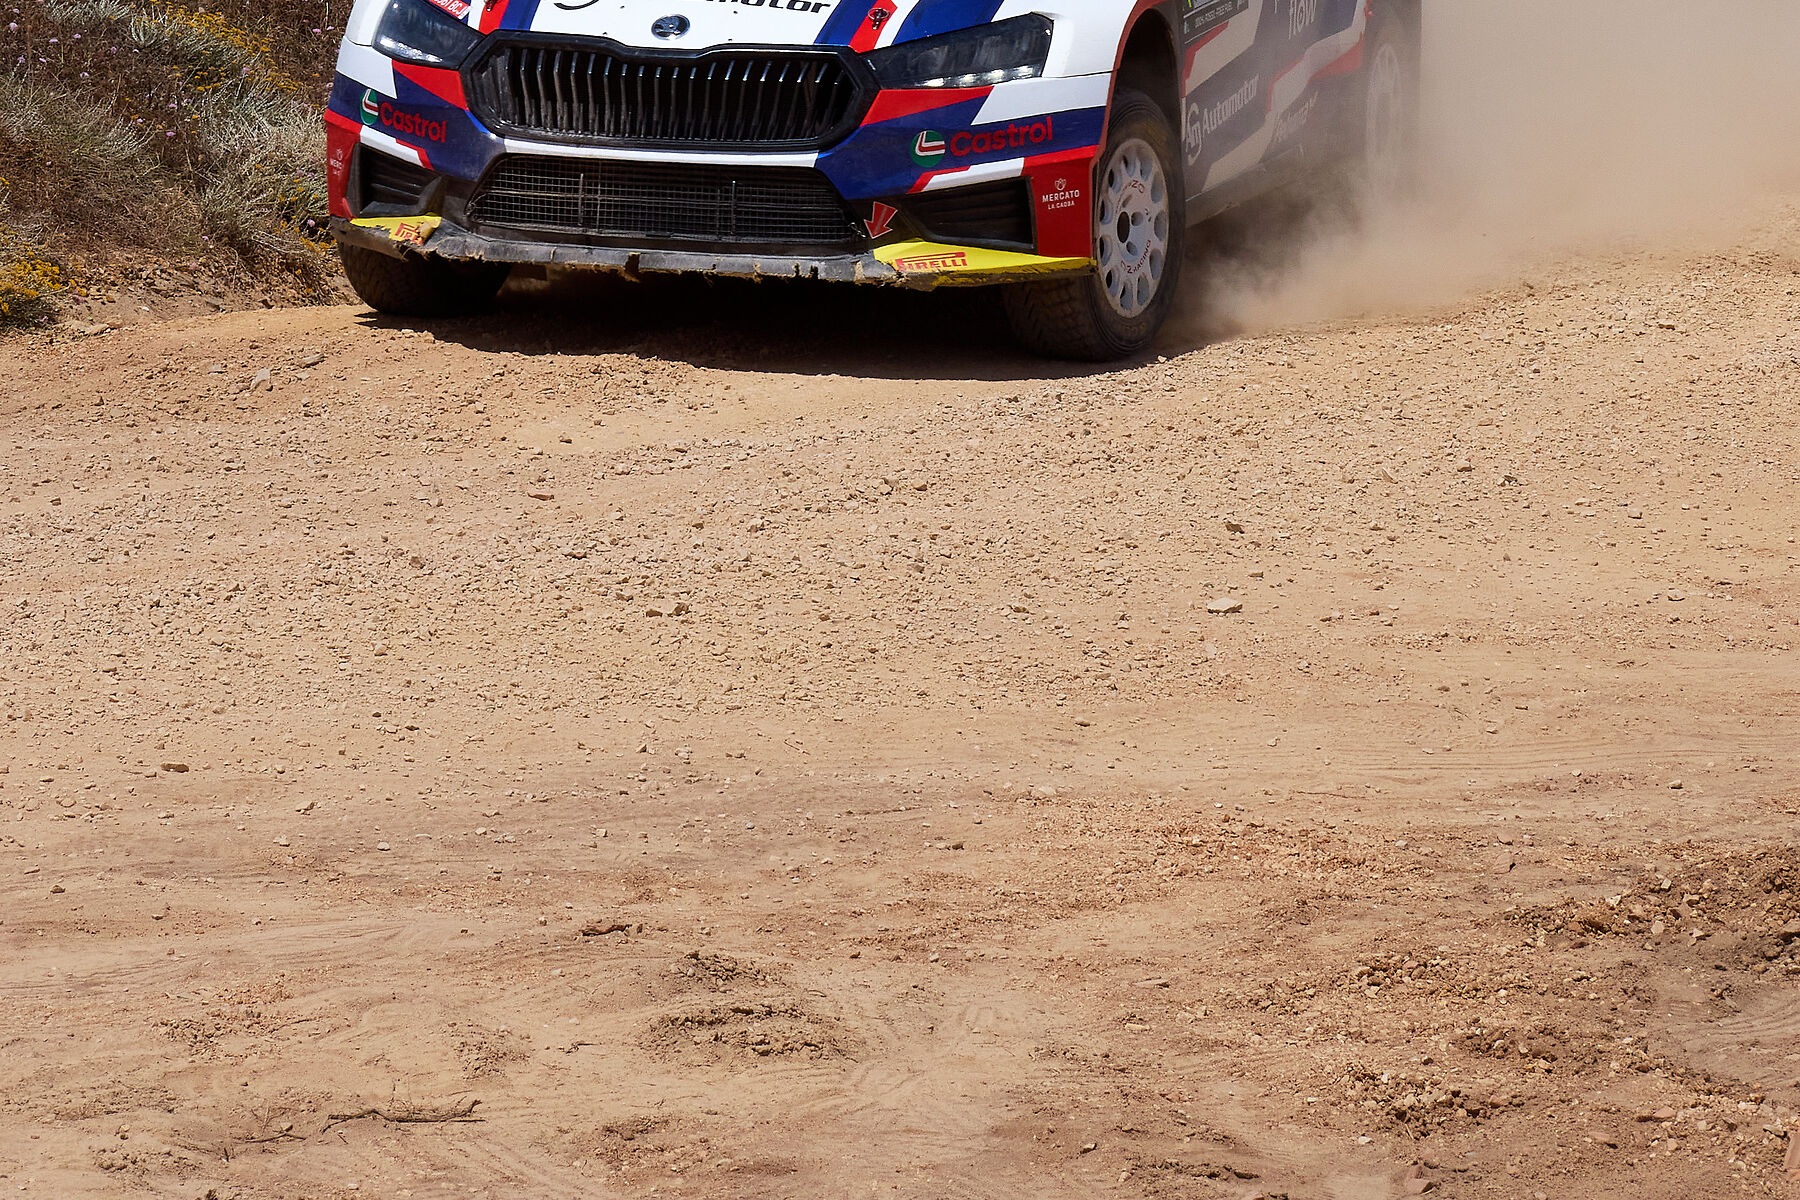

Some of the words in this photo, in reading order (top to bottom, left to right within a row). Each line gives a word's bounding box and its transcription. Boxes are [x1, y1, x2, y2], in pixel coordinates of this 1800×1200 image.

[379, 102, 446, 143] Castrol
[1201, 72, 1260, 137] Automotor
[950, 116, 1053, 157] Castrol
[1042, 189, 1080, 203] MERCATO
[895, 251, 967, 272] PIRELLI
